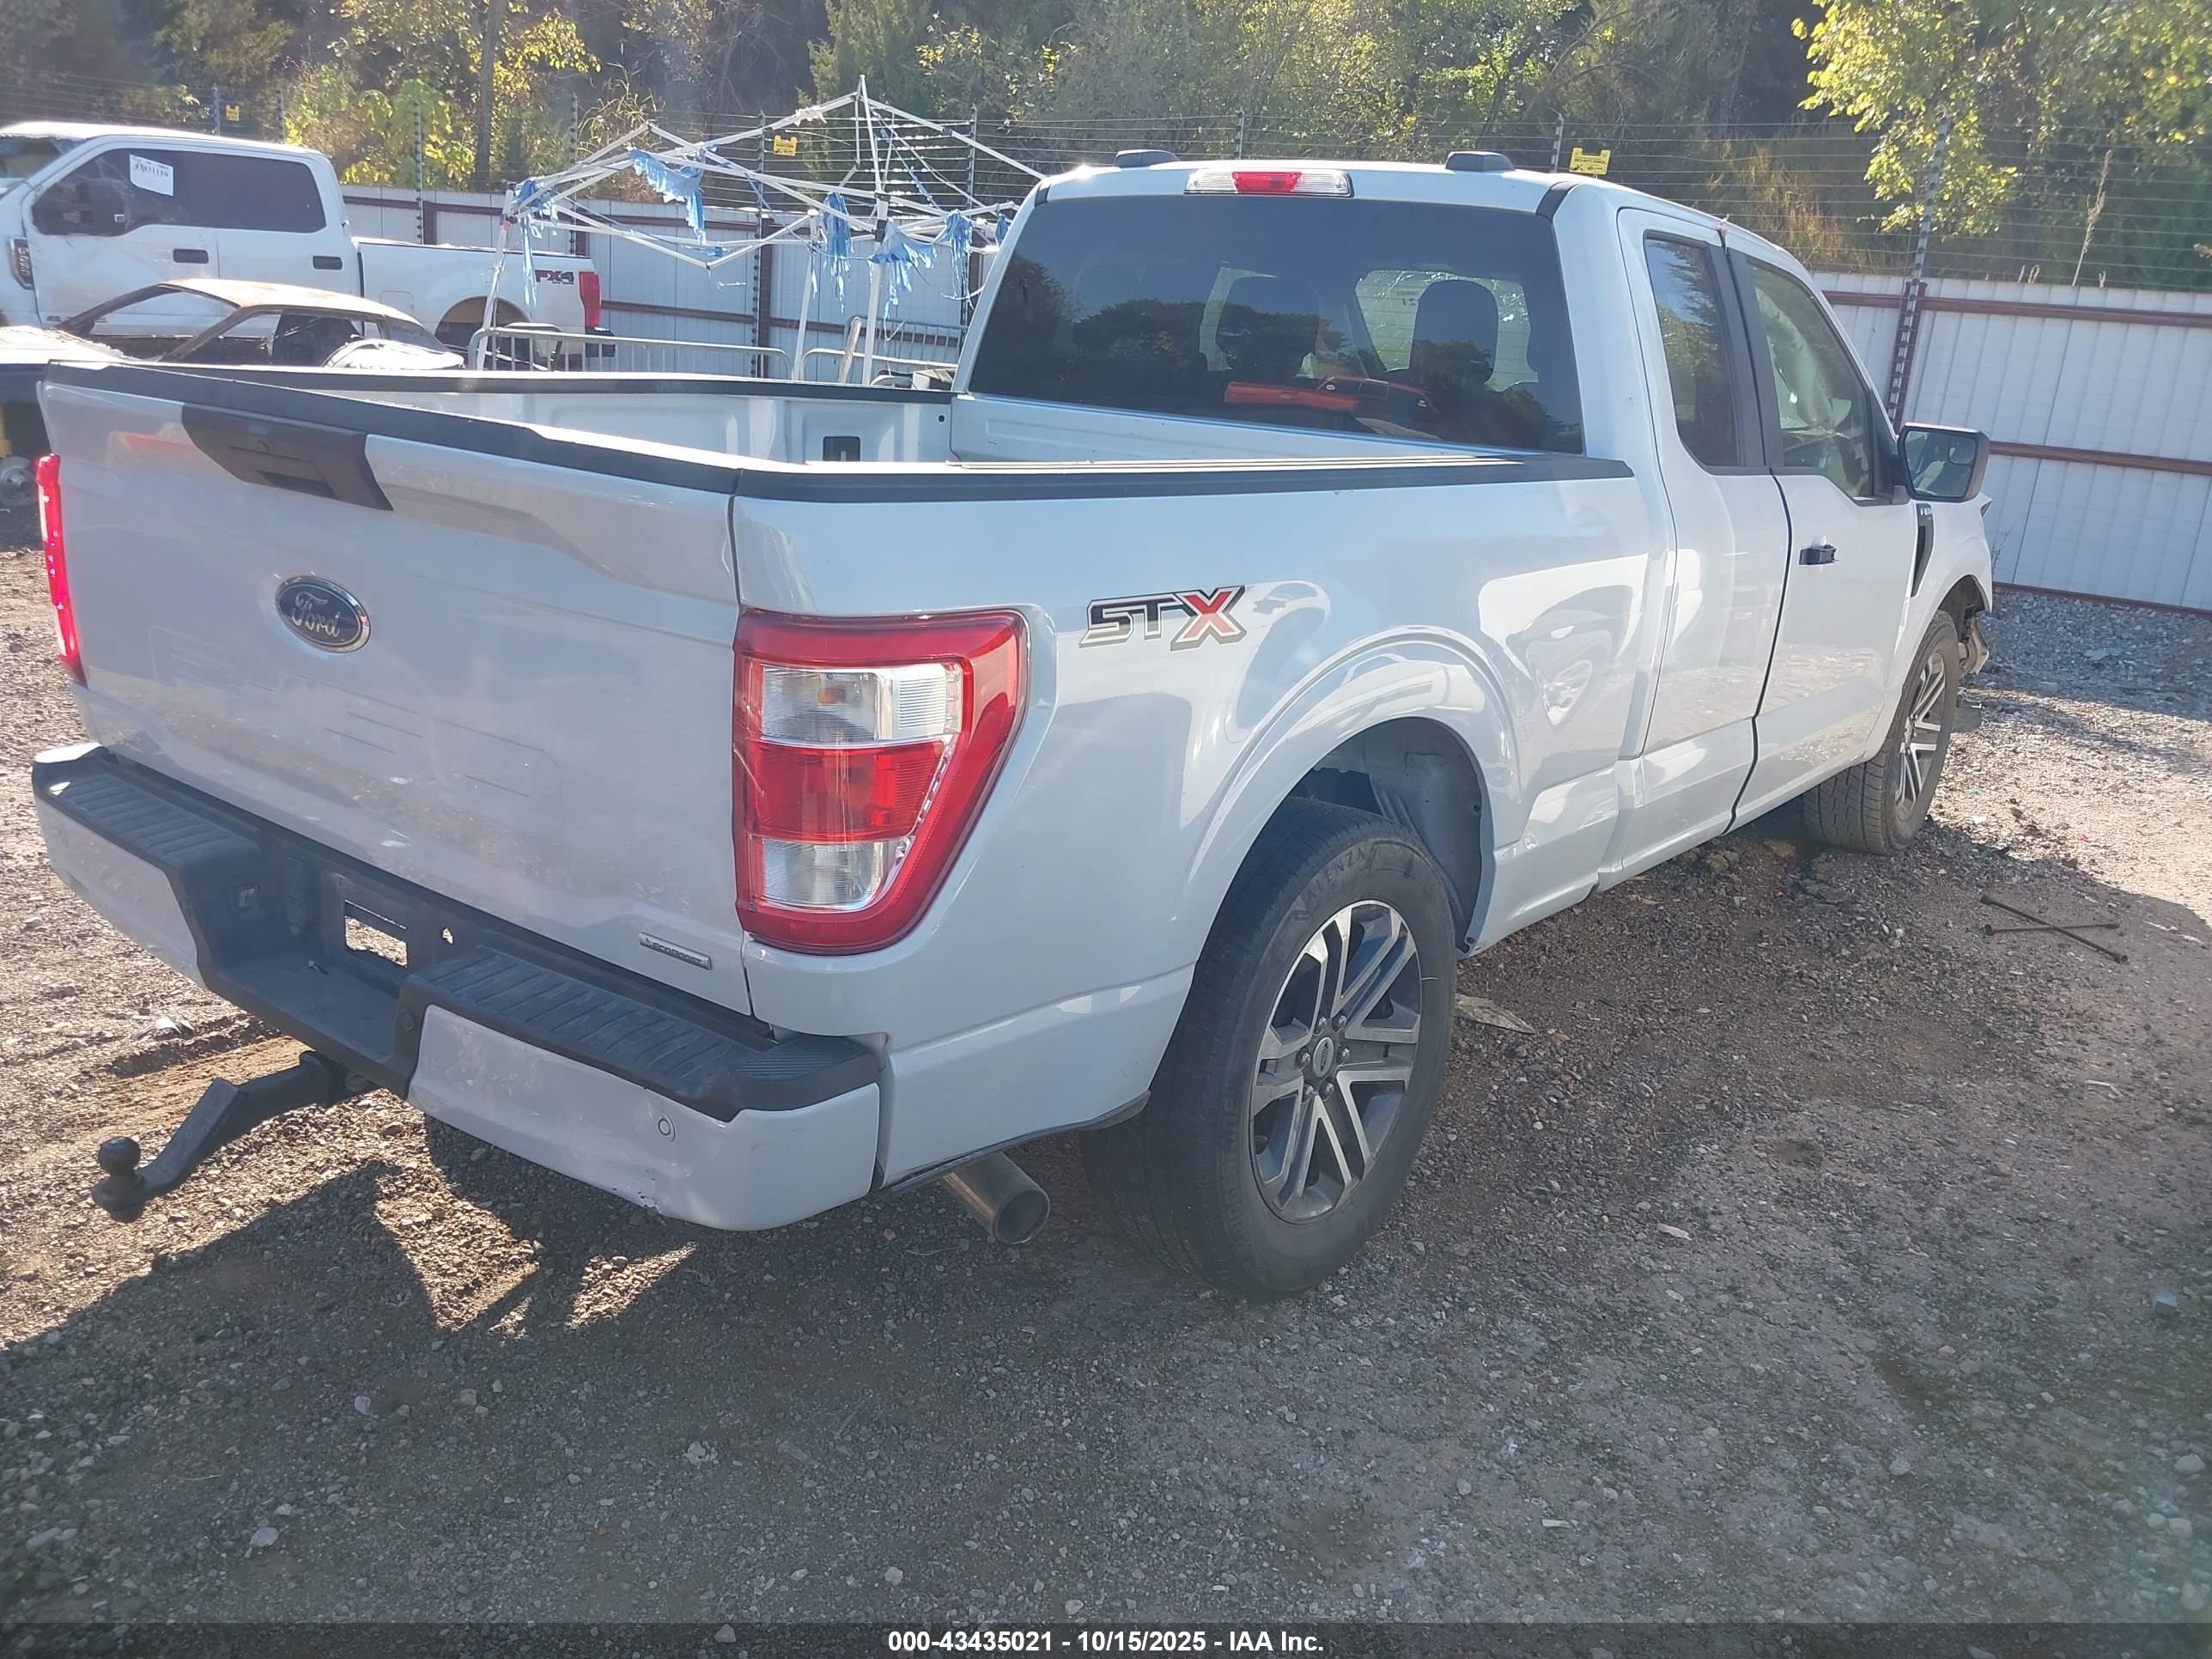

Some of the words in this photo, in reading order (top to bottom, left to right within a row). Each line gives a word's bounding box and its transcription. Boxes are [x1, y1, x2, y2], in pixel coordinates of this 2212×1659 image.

[534, 270, 574, 283] FX4
[292, 591, 341, 637] Ford
[1079, 584, 1248, 651] STX
